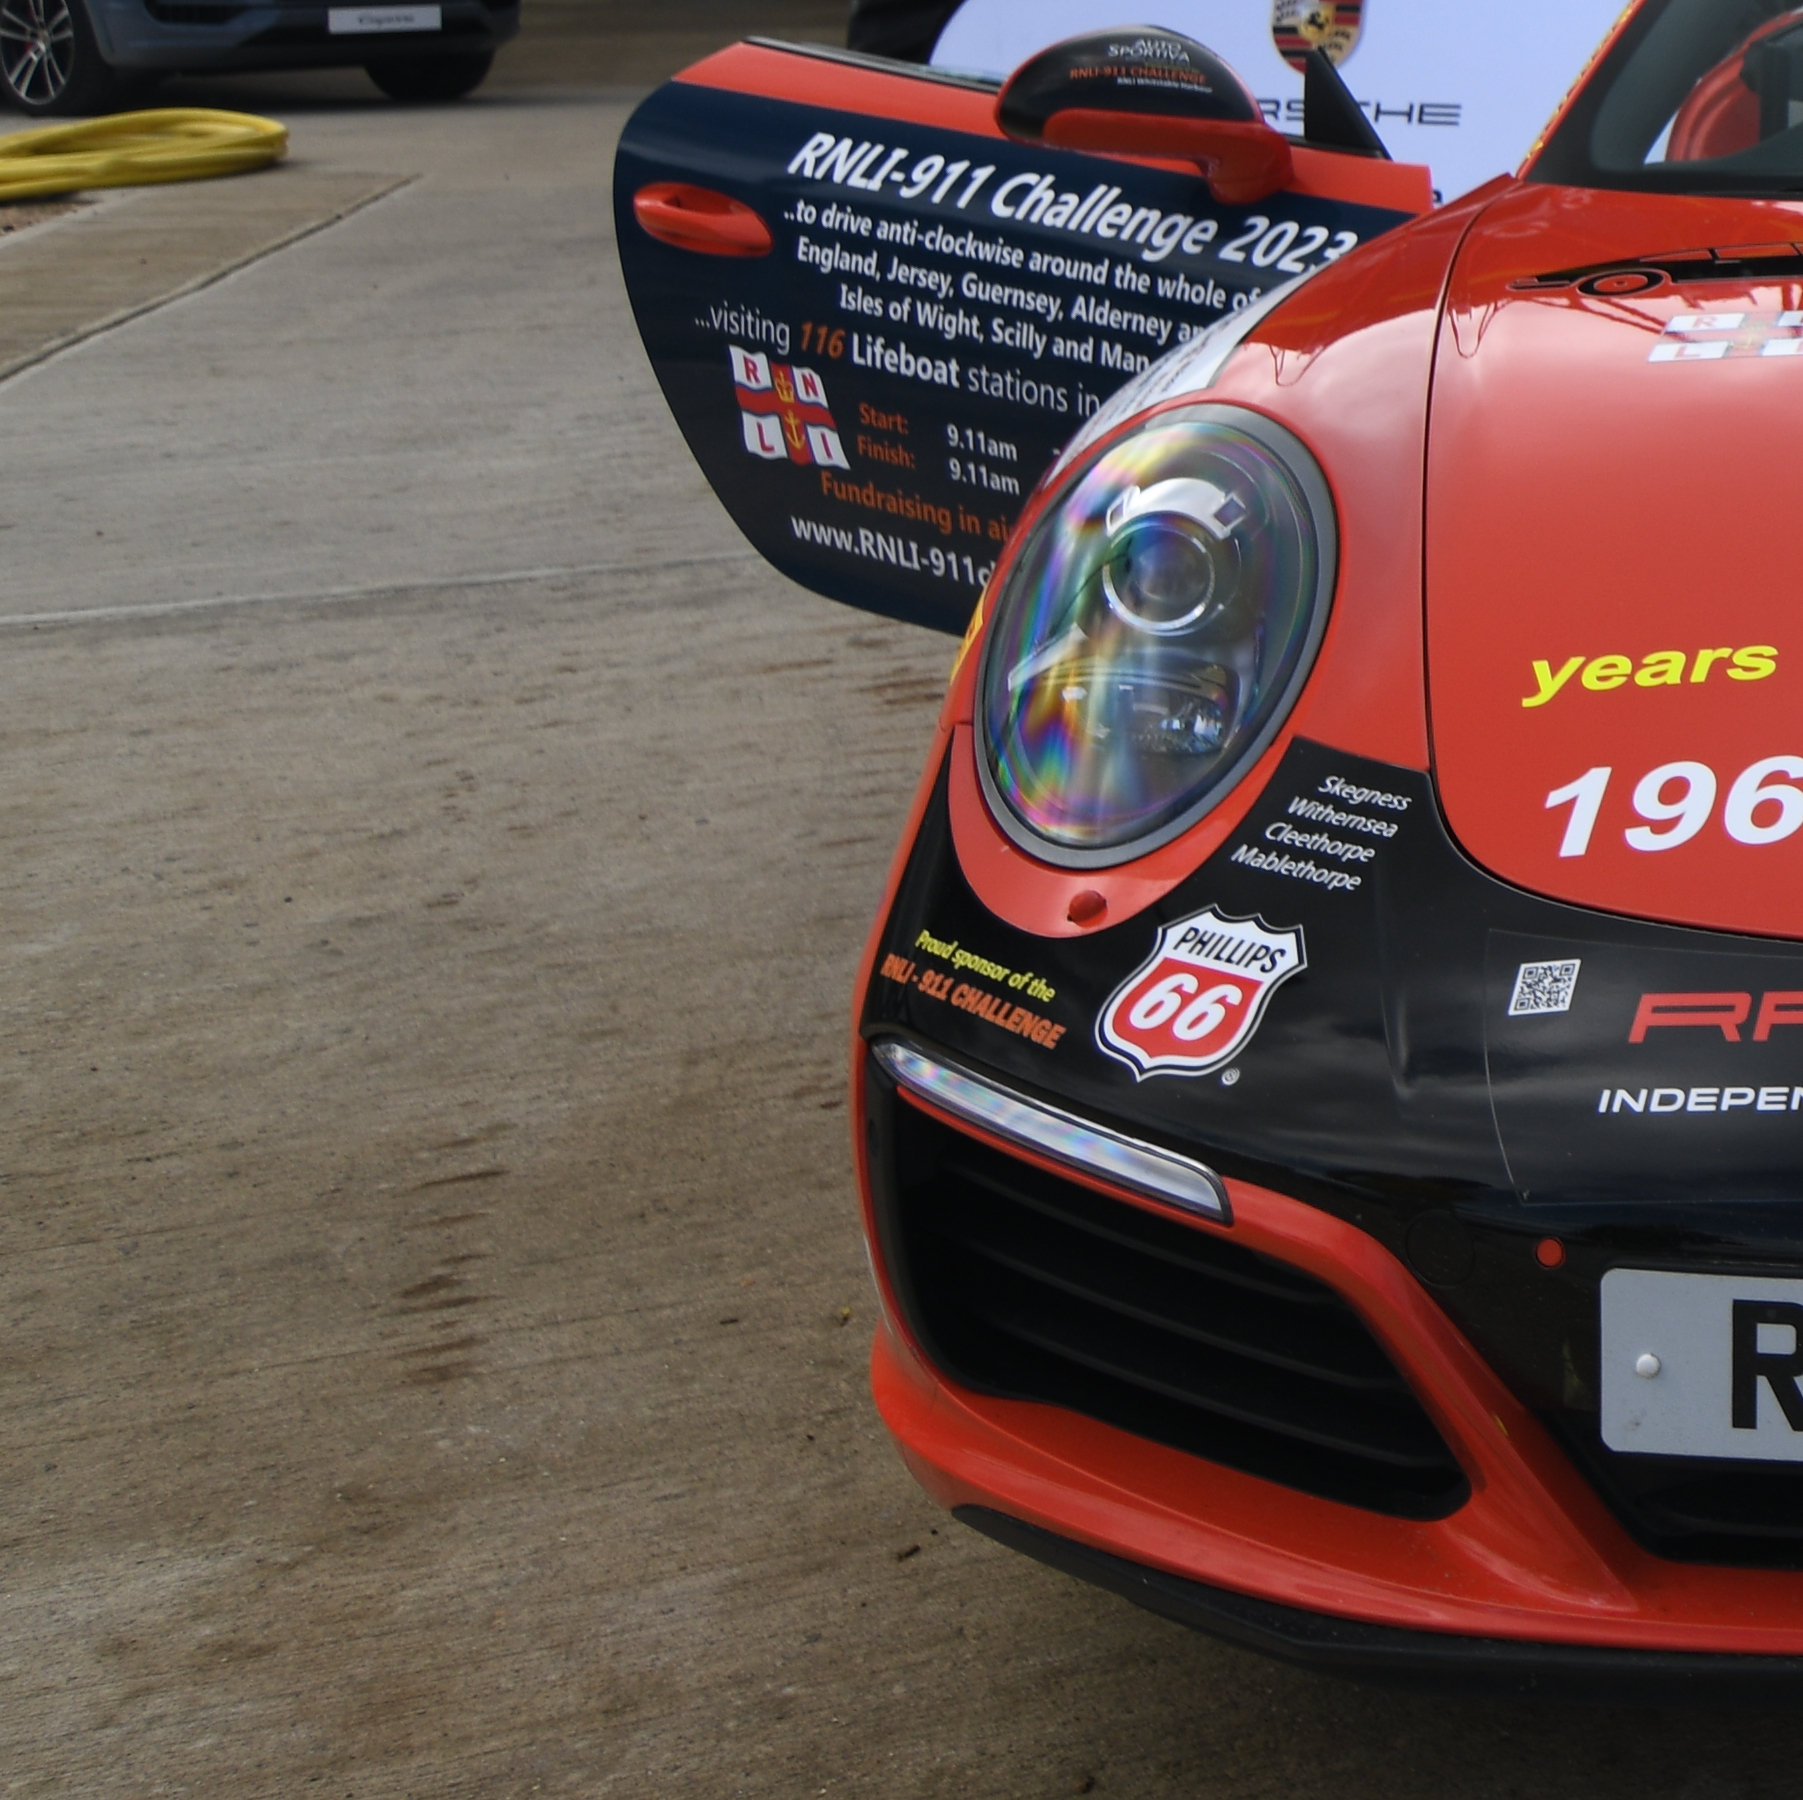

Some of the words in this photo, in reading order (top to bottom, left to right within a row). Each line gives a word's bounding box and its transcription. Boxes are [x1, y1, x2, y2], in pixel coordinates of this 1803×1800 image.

[1130, 67, 1207, 84] CHALLENGE
[787, 132, 996, 209] RNLI-911
[991, 172, 1218, 262] Challenge
[821, 202, 872, 236] drive
[876, 219, 1024, 268] anti-clockwise
[1028, 256, 1110, 285] around
[1114, 263, 1150, 294] the
[1157, 273, 1226, 309] whole
[797, 235, 881, 281] England,
[887, 256, 954, 298] Jersey,
[962, 272, 1065, 322] Guernsey,
[1070, 295, 1173, 346] Alderney
[840, 283, 883, 317] Isles
[889, 296, 911, 322] of
[917, 300, 983, 343] Wight,
[991, 317, 1047, 359] Scilly
[1052, 334, 1094, 363] and
[695, 300, 790, 355] ...visiting
[801, 321, 846, 358] 116
[852, 332, 960, 389] Lifeboat
[968, 363, 1068, 412] stations
[1077, 382, 1100, 417] in
[857, 435, 916, 469] Finish:
[949, 457, 1020, 495] 9.11am
[859, 402, 908, 434] Start:
[948, 423, 1018, 462] 9.11am
[821, 470, 953, 535] Fundraising
[958, 505, 981, 534] in
[1520, 637, 1777, 707] years
[1287, 795, 1400, 839] Withernsea
[1317, 774, 1412, 811] Skegness
[1231, 843, 1363, 892] Mablethorpe
[1264, 821, 1376, 864] Cleethorpe
[915, 929, 959, 960] Proud
[951, 947, 1011, 983] sponsor
[1008, 964, 1033, 990] of
[1027, 978, 1057, 1002] the
[1171, 925, 1287, 975] PHILLIPS
[880, 953, 916, 984] RNLI
[917, 969, 954, 1000] 911
[950, 983, 1067, 1049] CHALLENGE
[1129, 971, 1243, 1042] 66
